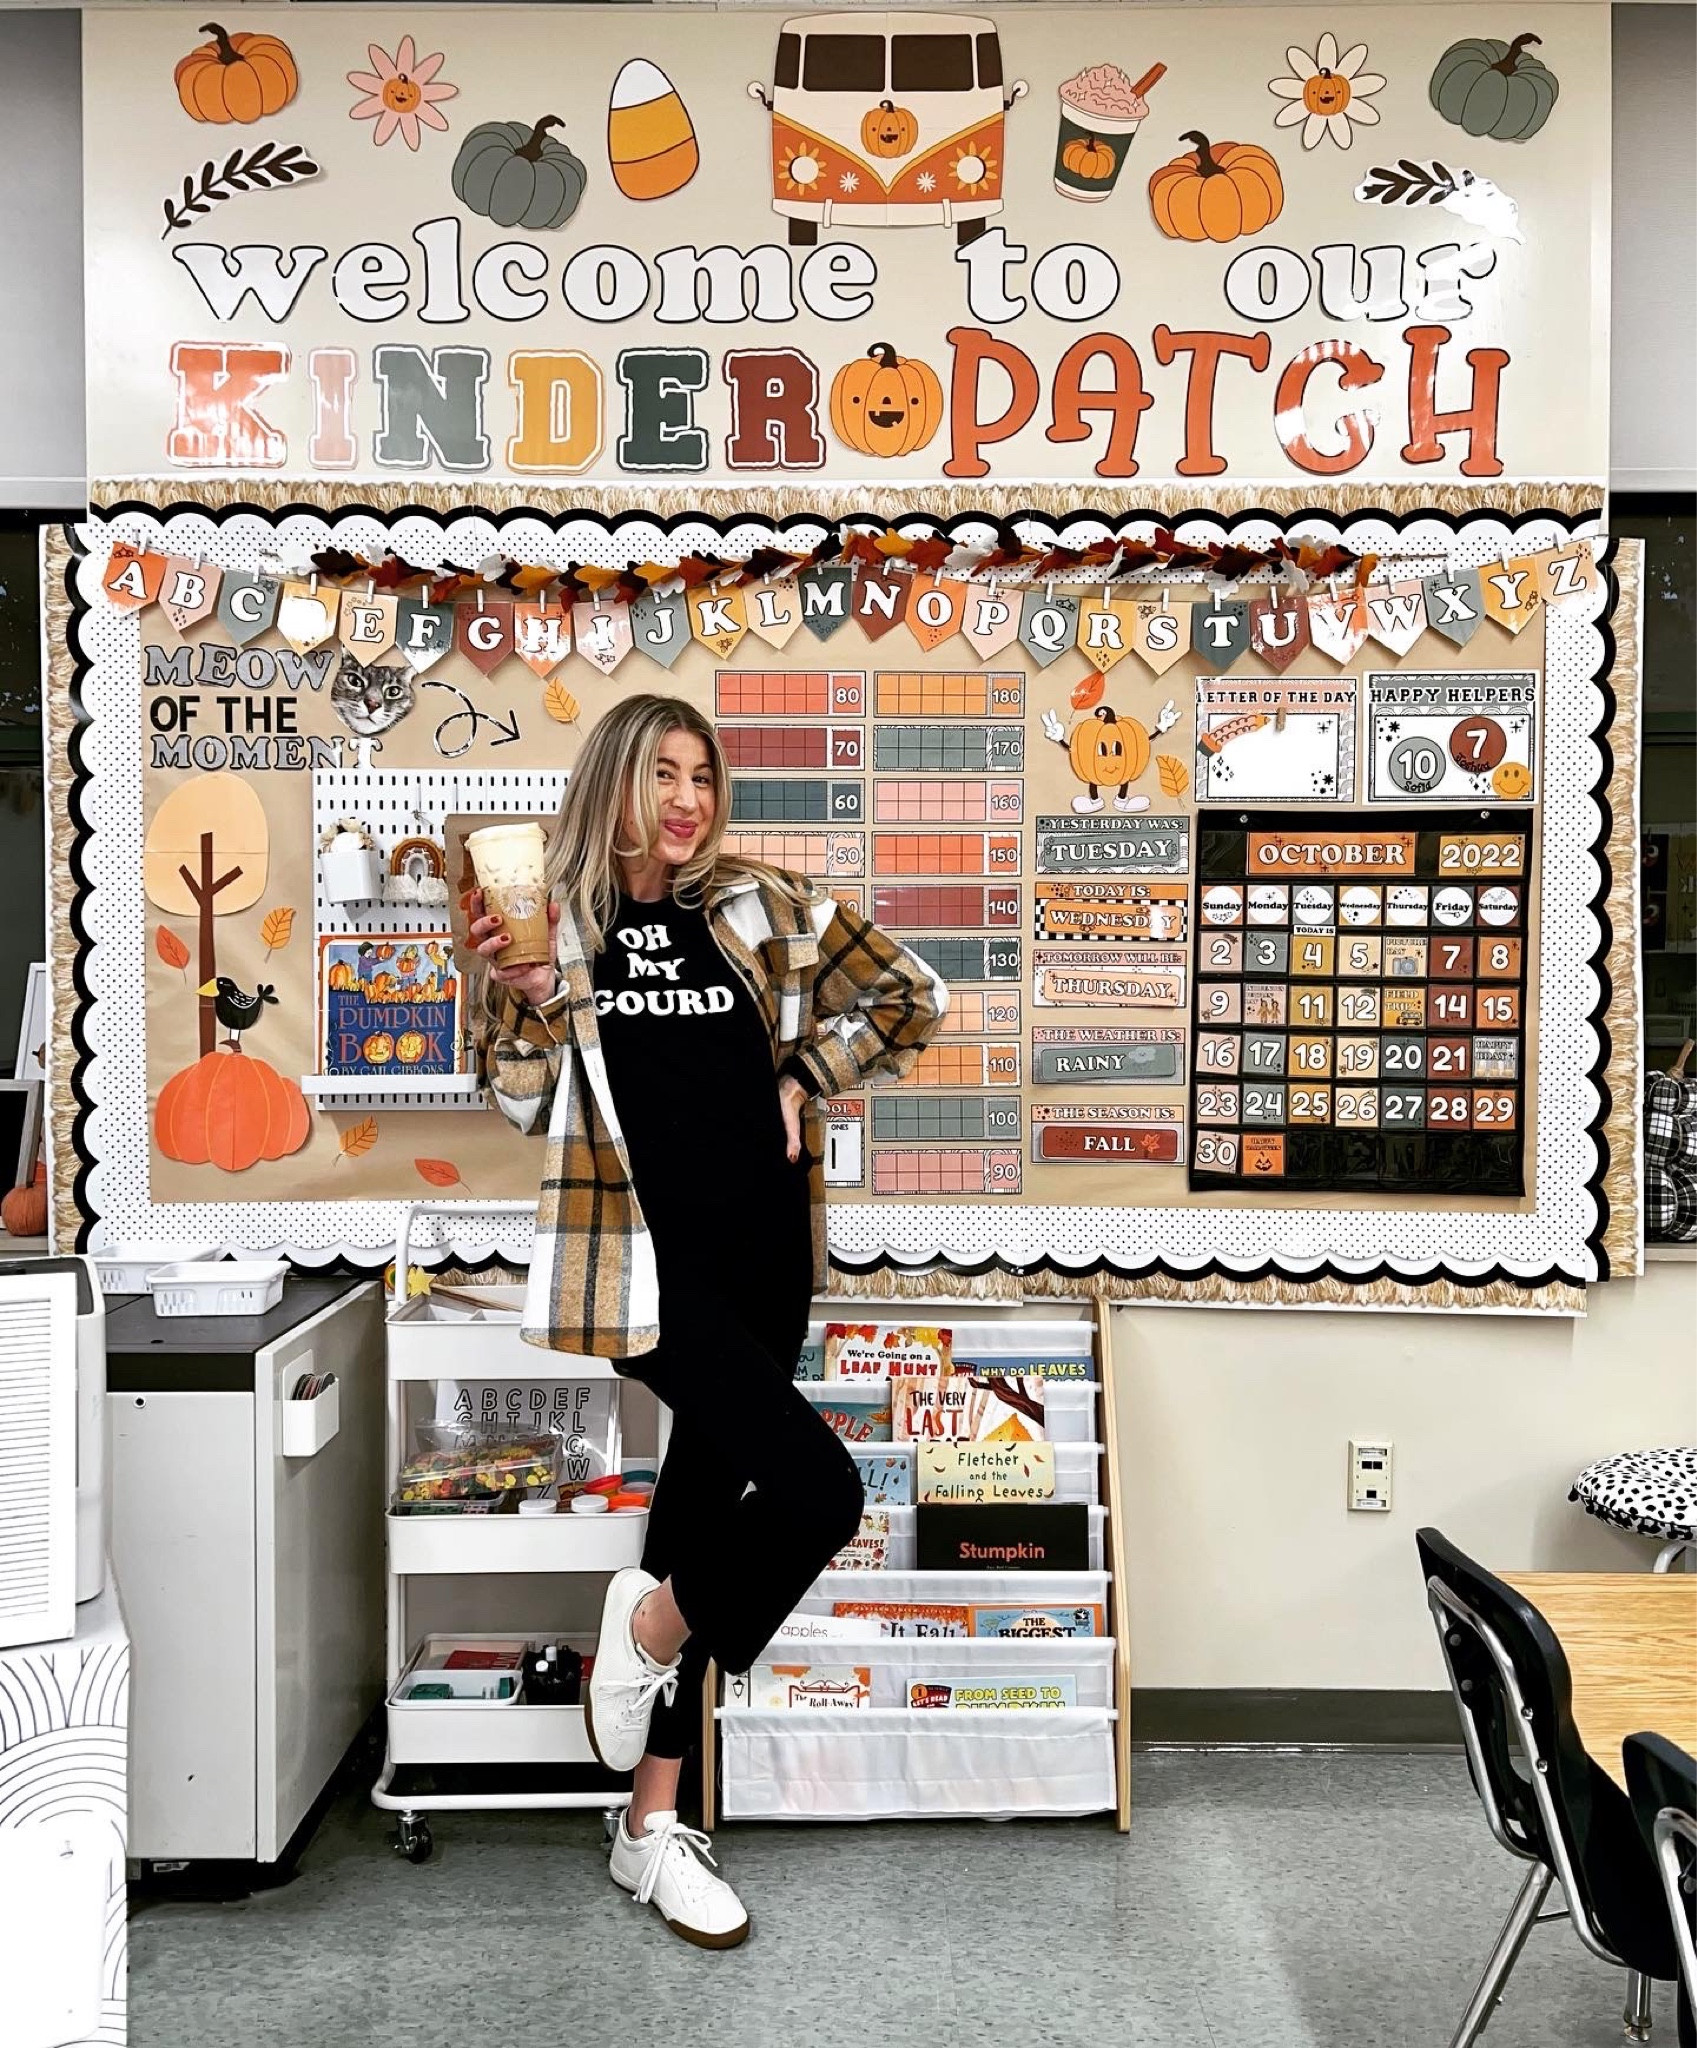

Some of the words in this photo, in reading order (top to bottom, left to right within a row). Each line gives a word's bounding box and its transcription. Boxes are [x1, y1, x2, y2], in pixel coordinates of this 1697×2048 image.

[172, 217, 878, 323] welcome
[956, 226, 1120, 323] to
[1225, 242, 1497, 323] our
[166, 341, 827, 471] KINDER
[942, 324, 1511, 478] PATCH
[144, 642, 334, 690] MEOW
[835, 687, 860, 704] 80
[991, 688, 1020, 704] 180
[1196, 691, 1257, 703] LETTER
[1263, 691, 1282, 703] OF
[1287, 691, 1318, 703] THE
[1324, 691, 1356, 703] DAY
[1370, 688, 1440, 702] HAPPY
[1447, 687, 1535, 702] HELPERS
[150, 695, 200, 732] OF
[216, 696, 298, 734] THE
[150, 734, 383, 770] MOMENT
[834, 740, 859, 757] 70
[993, 741, 1021, 756] 170
[1466, 728, 1488, 759] 7
[1398, 748, 1438, 781] 10
[834, 794, 859, 810] 60
[991, 796, 1020, 811] 160
[1049, 819, 1142, 830] YESTERDAY
[1148, 819, 1184, 830] WAS:
[835, 847, 860, 864] 50
[990, 848, 1018, 863] 150
[1051, 839, 1172, 861] TUESDAY
[1258, 843, 1407, 866] OCTOBER
[1440, 843, 1521, 869] 2022
[1073, 885, 1126, 897] TODAY
[1130, 885, 1151, 897] IS:
[988, 900, 1018, 915] 140
[1202, 902, 1243, 911] Sunday
[1248, 901, 1289, 911] Monday
[1293, 902, 1334, 911] Tuesday
[1386, 902, 1428, 911] Thursday
[1435, 902, 1470, 912] Friday
[1478, 903, 1519, 911] Saturday
[1050, 910, 1176, 929] WEDNESDY
[616, 924, 672, 951] OH
[989, 953, 1019, 967] 130
[1044, 953, 1121, 962] TOMORROW
[1124, 953, 1158, 962] WILL
[1210, 938, 1232, 965] 2
[1256, 939, 1277, 965] 3
[1303, 942, 1323, 968] 4
[1349, 942, 1369, 968] 5
[1442, 944, 1461, 970] 7
[1491, 944, 1509, 970] 8
[626, 952, 685, 981] MY
[1053, 978, 1172, 998] THURSDAY
[338, 995, 360, 1006] THE
[594, 985, 735, 1016] GOURD
[1210, 990, 1229, 1016] 9
[1297, 993, 1326, 1020] 11
[1341, 994, 1377, 1020] 12
[1434, 994, 1467, 1019] 14
[1482, 996, 1513, 1021] 15
[338, 1005, 448, 1030] PUMPKIN
[988, 1007, 1018, 1021] 120
[1042, 1030, 1076, 1040] THE
[1079, 1030, 1157, 1040] WEATHER
[1161, 1030, 1182, 1041] IS:
[1202, 1038, 1235, 1067] 16
[1249, 1040, 1282, 1067] 17
[1294, 1043, 1327, 1070] 18
[1342, 1044, 1375, 1071] 19
[1384, 1044, 1423, 1071] 20
[1431, 1045, 1467, 1072] 21
[989, 1057, 1016, 1072] 110
[1056, 1054, 1125, 1072] RAINY
[1198, 1090, 1238, 1116] 23
[1245, 1090, 1283, 1117] 24
[1291, 1091, 1329, 1117] 25
[1337, 1093, 1377, 1120] 26
[1384, 1094, 1423, 1121] 27
[1430, 1096, 1468, 1122] 28
[1475, 1096, 1515, 1123] 29
[988, 1111, 1017, 1126] 100
[1052, 1108, 1085, 1118] THE
[1088, 1108, 1151, 1118] SEASON
[1155, 1108, 1175, 1119] IS:
[831, 1123, 849, 1131] ONES
[1083, 1136, 1136, 1152] FALL
[1197, 1138, 1237, 1165] 30
[993, 1165, 1017, 1180] 90
[847, 1349, 875, 1358] We're
[877, 1351, 907, 1361] Going
[840, 1359, 881, 1375] LEAF
[888, 1361, 938, 1376] HUNT
[980, 1367, 1006, 1376] WHY
[1010, 1367, 1026, 1376] DO
[1029, 1363, 1087, 1376] LEAVES
[909, 1390, 935, 1407] THE
[938, 1391, 967, 1406] VERY
[904, 1408, 964, 1436] LAST
[958, 1452, 1019, 1466] Fletcher
[969, 1472, 987, 1480] and
[992, 1472, 1008, 1480] the
[935, 1484, 985, 1503] Falling
[993, 1485, 1043, 1498] Leaves
[959, 1541, 1045, 1563] Stumpkin
[780, 1622, 828, 1638] apples
[1023, 1617, 1046, 1626] THE
[955, 1688, 998, 1701] FROM
[1001, 1687, 1037, 1700] SEED
[1040, 1686, 1062, 1699] TO
